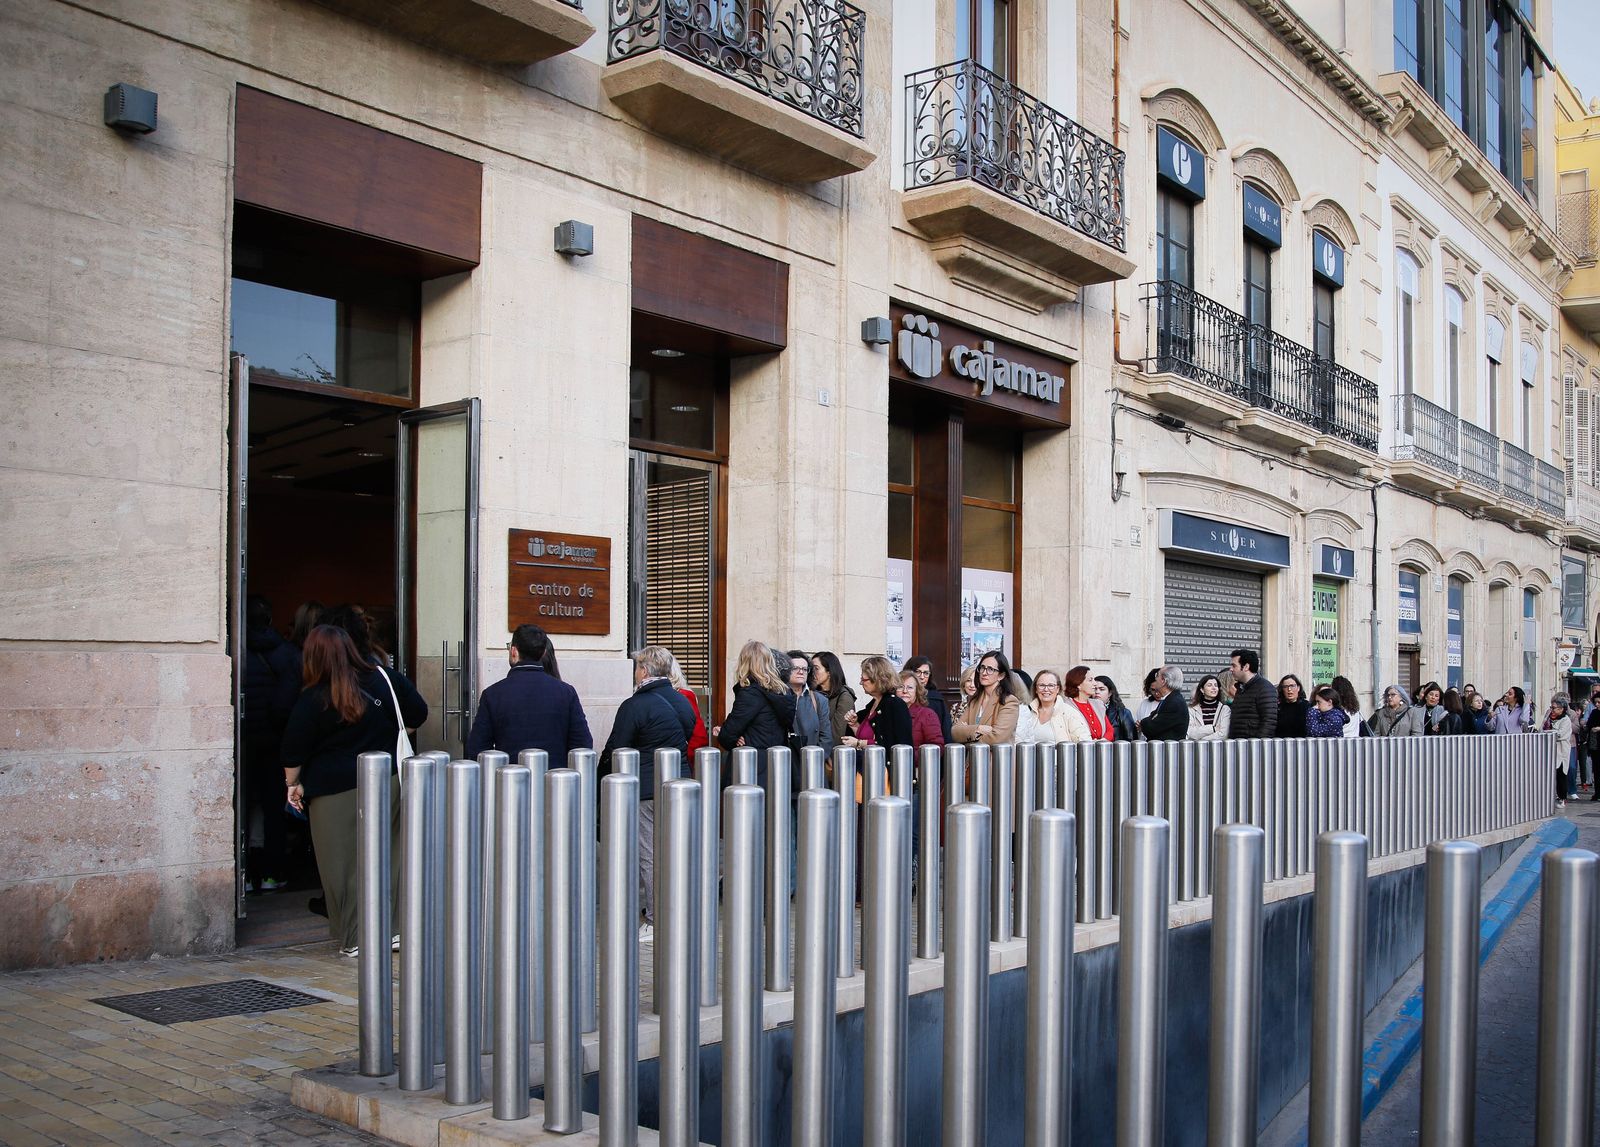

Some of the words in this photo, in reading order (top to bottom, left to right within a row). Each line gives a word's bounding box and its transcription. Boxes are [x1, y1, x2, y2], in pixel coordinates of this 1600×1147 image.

[950, 340, 1065, 404] cajamar
[546, 541, 598, 559] cajamar
[529, 582, 571, 597] centro
[578, 583, 594, 598] de
[539, 602, 584, 617] cultura
[1318, 592, 1337, 613] VENDE
[1314, 621, 1337, 640] ALQUILA
